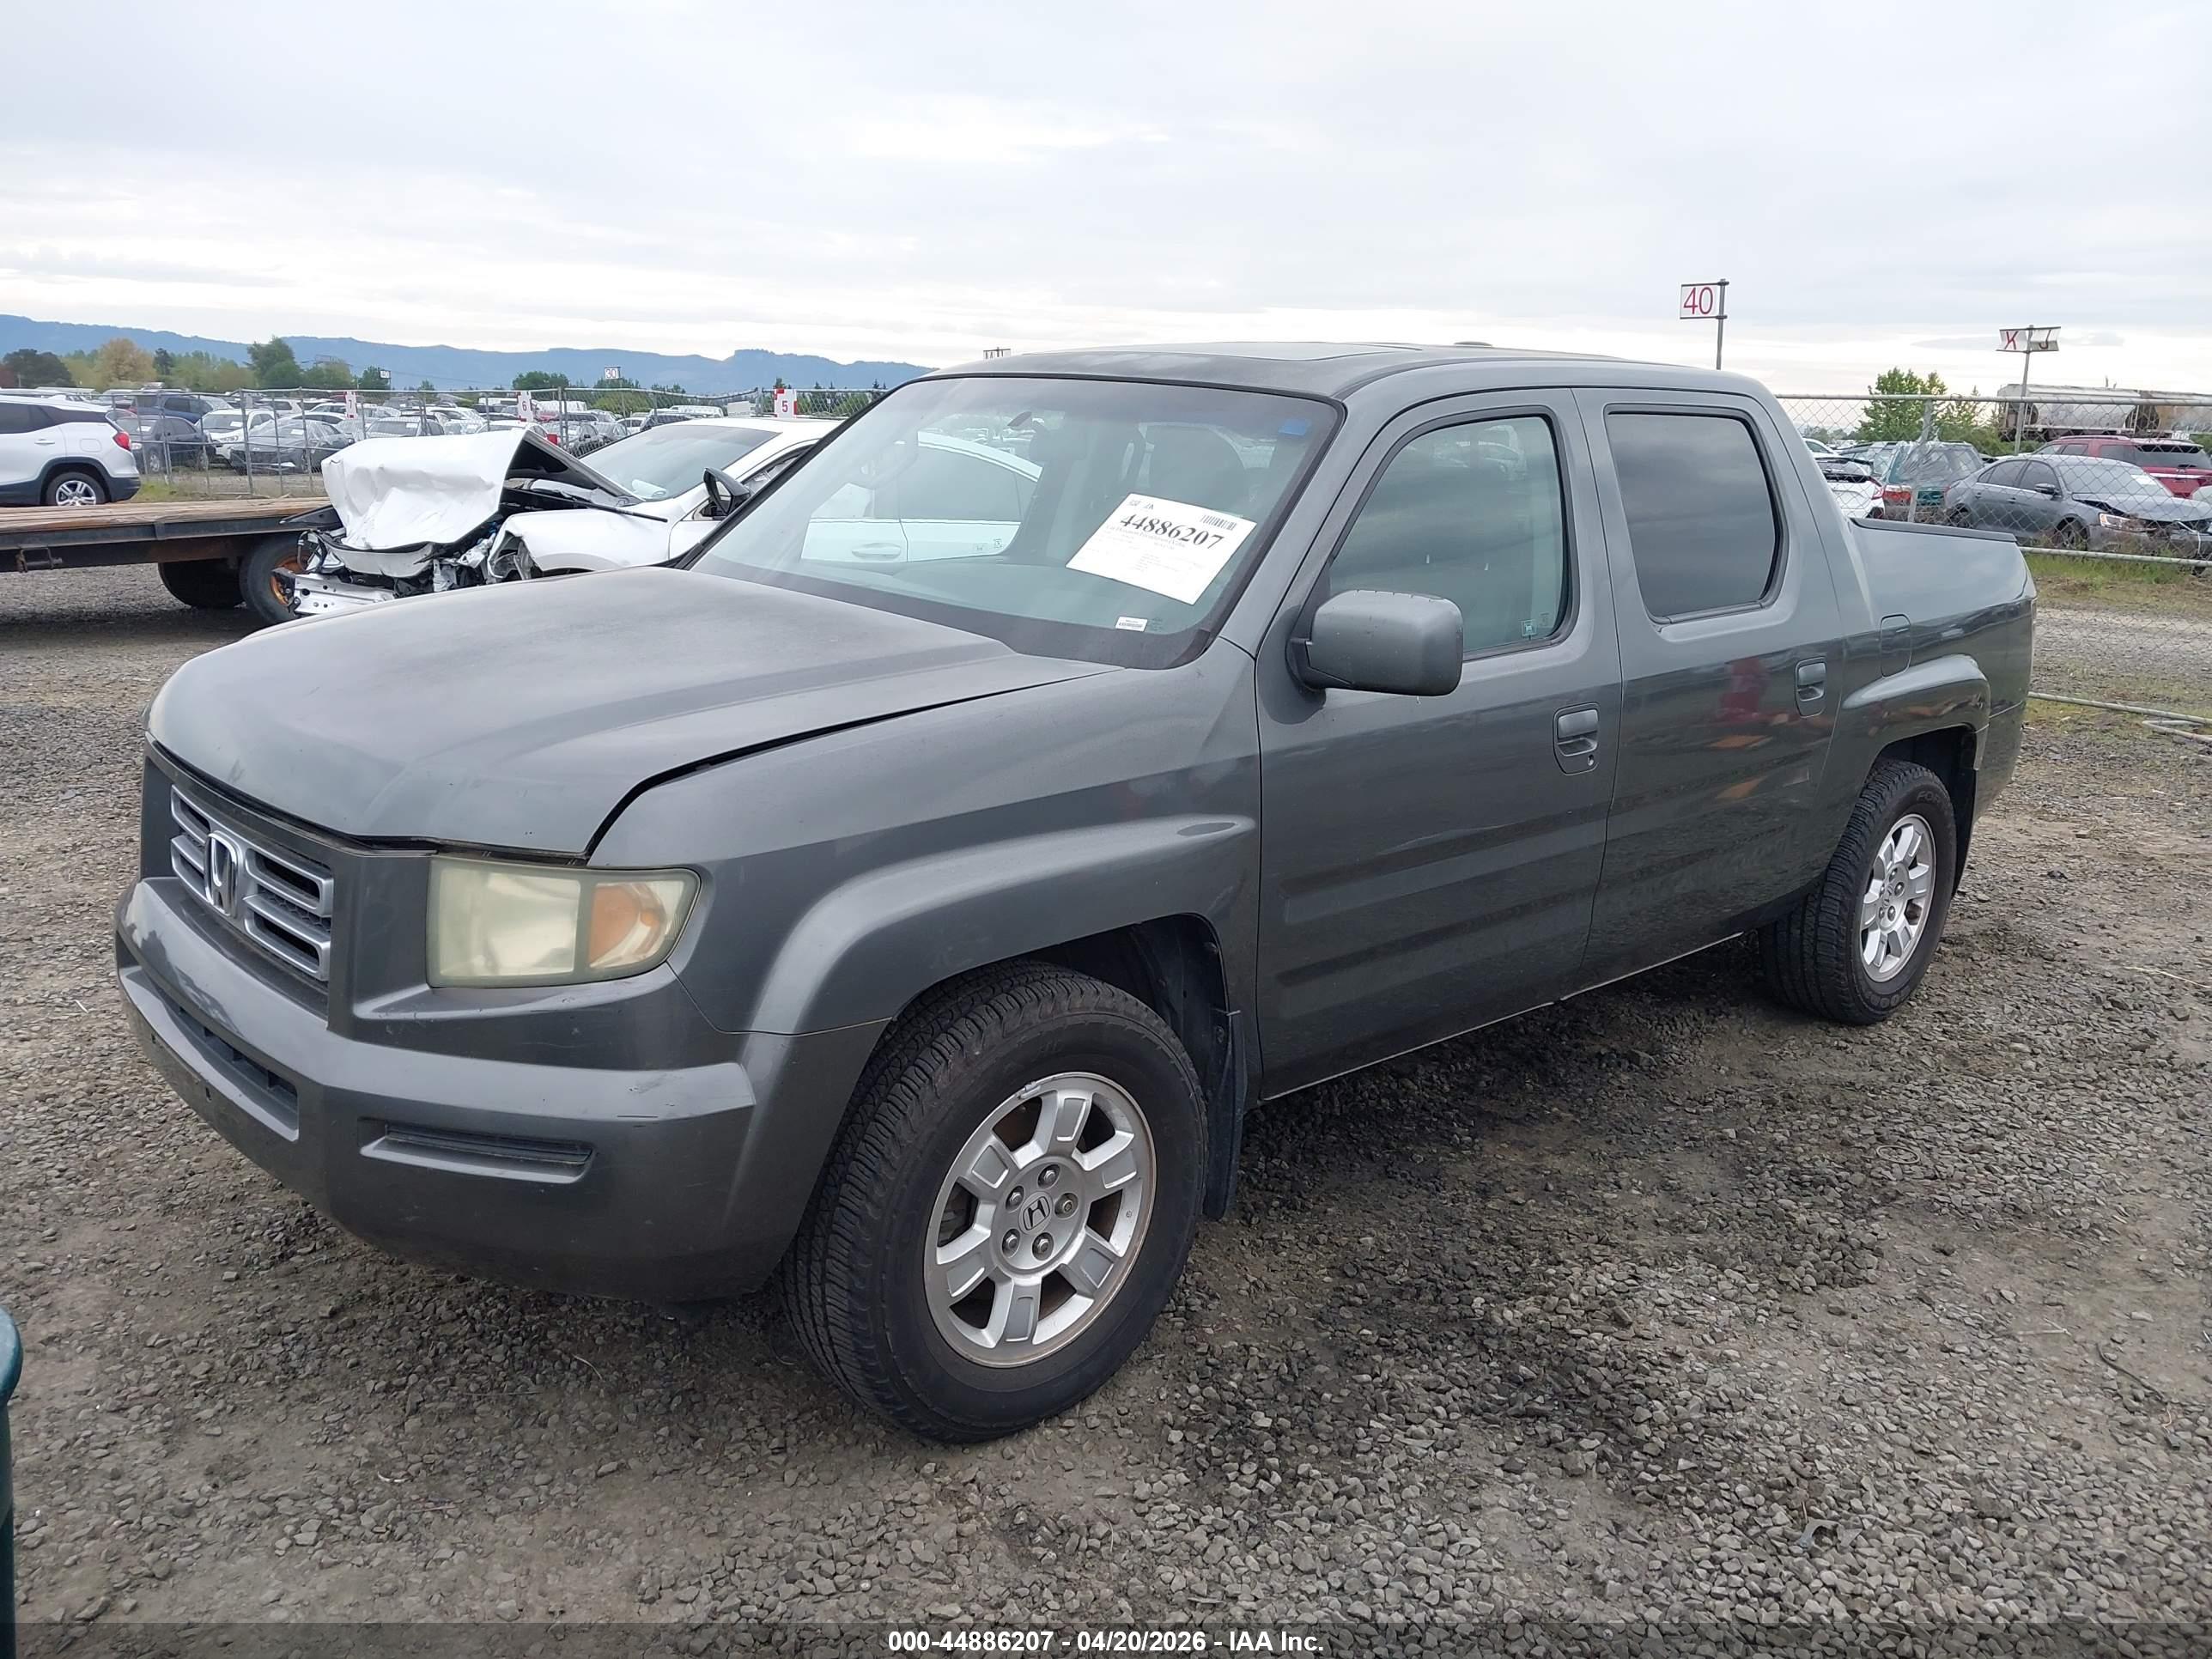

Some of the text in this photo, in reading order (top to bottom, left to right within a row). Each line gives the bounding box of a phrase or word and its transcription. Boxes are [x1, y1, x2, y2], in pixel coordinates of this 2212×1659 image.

[1683, 286, 1714, 315] 40
[2003, 330, 2019, 350] K
[2039, 329, 2051, 349] J
[605, 368, 617, 379] 30
[522, 400, 527, 411] 6
[782, 400, 788, 413] 5
[1121, 514, 1225, 549] 44886207
